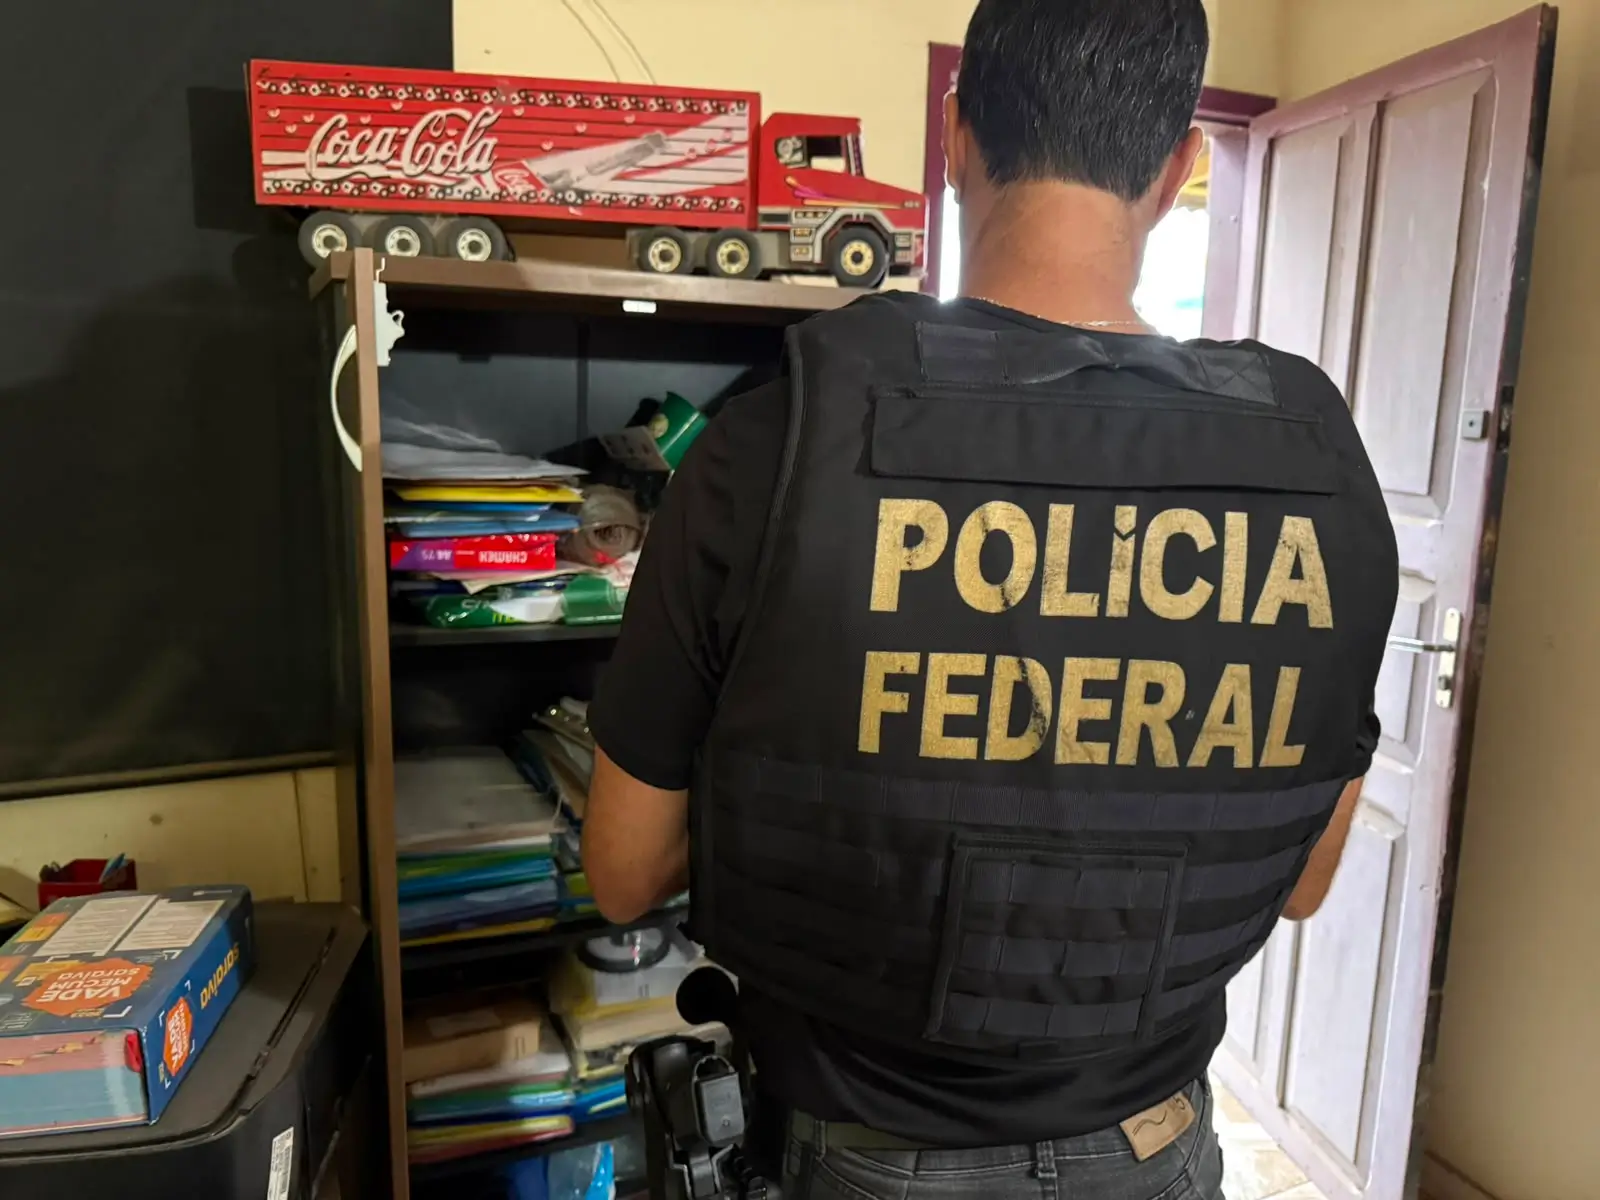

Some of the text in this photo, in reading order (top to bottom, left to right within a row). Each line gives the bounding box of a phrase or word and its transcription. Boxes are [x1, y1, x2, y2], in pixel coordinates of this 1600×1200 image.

[306, 107, 502, 180] Coca-Cola
[858, 651, 1306, 768] FEDERAL
[36, 986, 120, 1002] VADE
[47, 976, 132, 990] MECUM
[57, 967, 140, 980] saraiva
[200, 942, 240, 1009] saraiva
